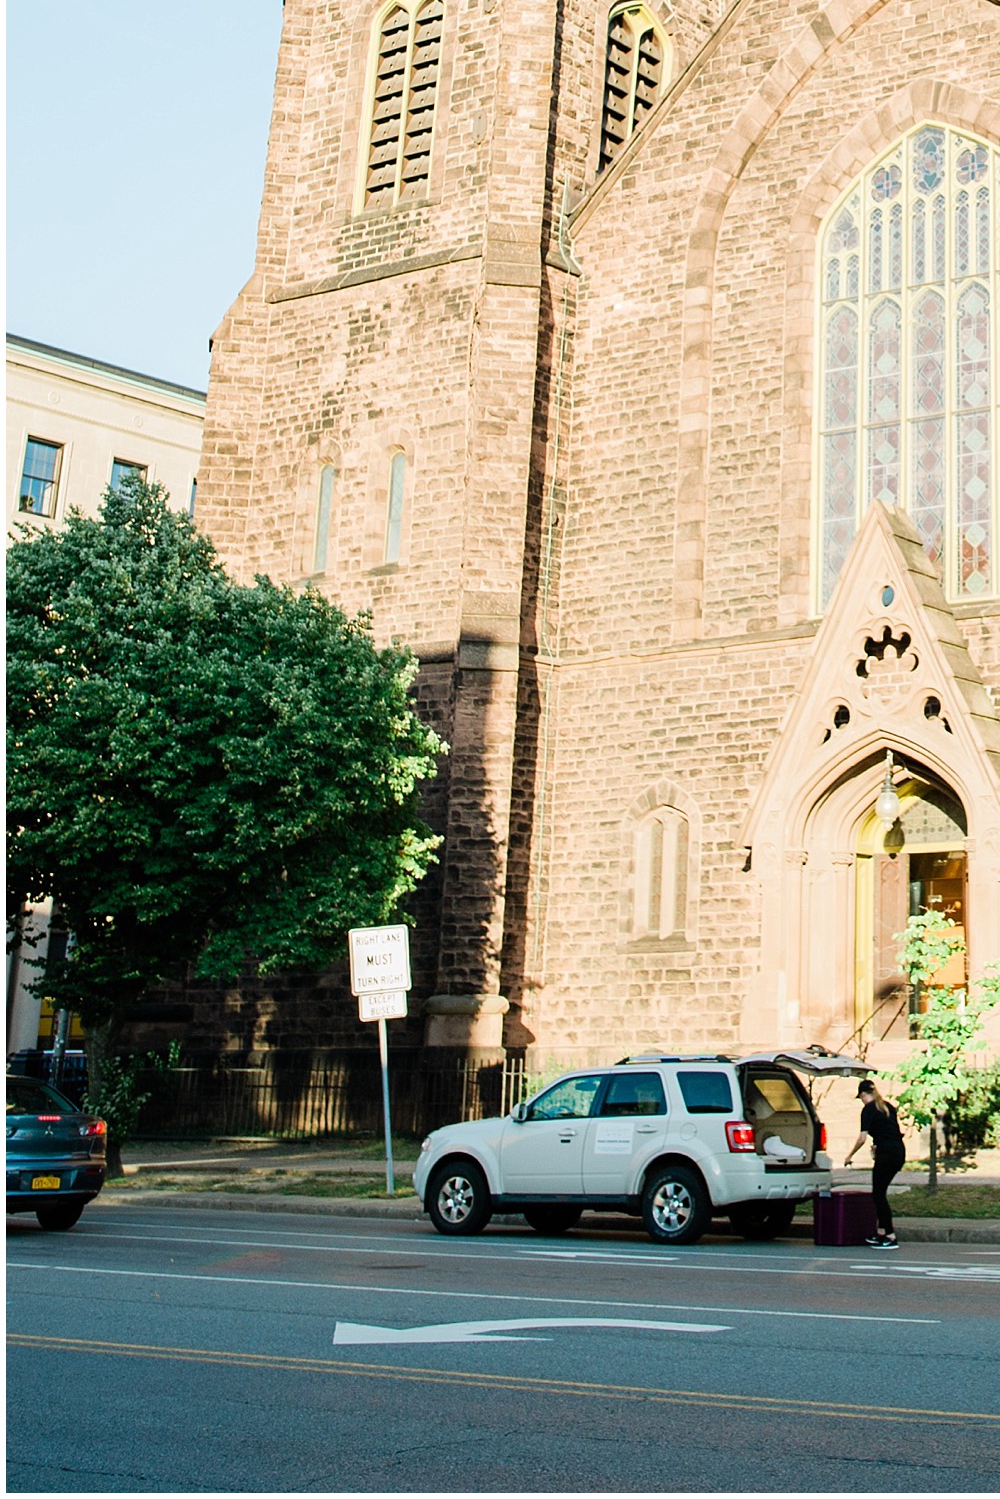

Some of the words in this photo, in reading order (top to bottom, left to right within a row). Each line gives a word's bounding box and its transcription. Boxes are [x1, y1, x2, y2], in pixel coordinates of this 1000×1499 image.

[356, 935, 378, 946] RIGHT
[367, 953, 393, 966] MUST
[358, 977, 379, 988] TURN
[381, 974, 404, 985] RIGHT
[369, 994, 396, 1005] EXCEPT
